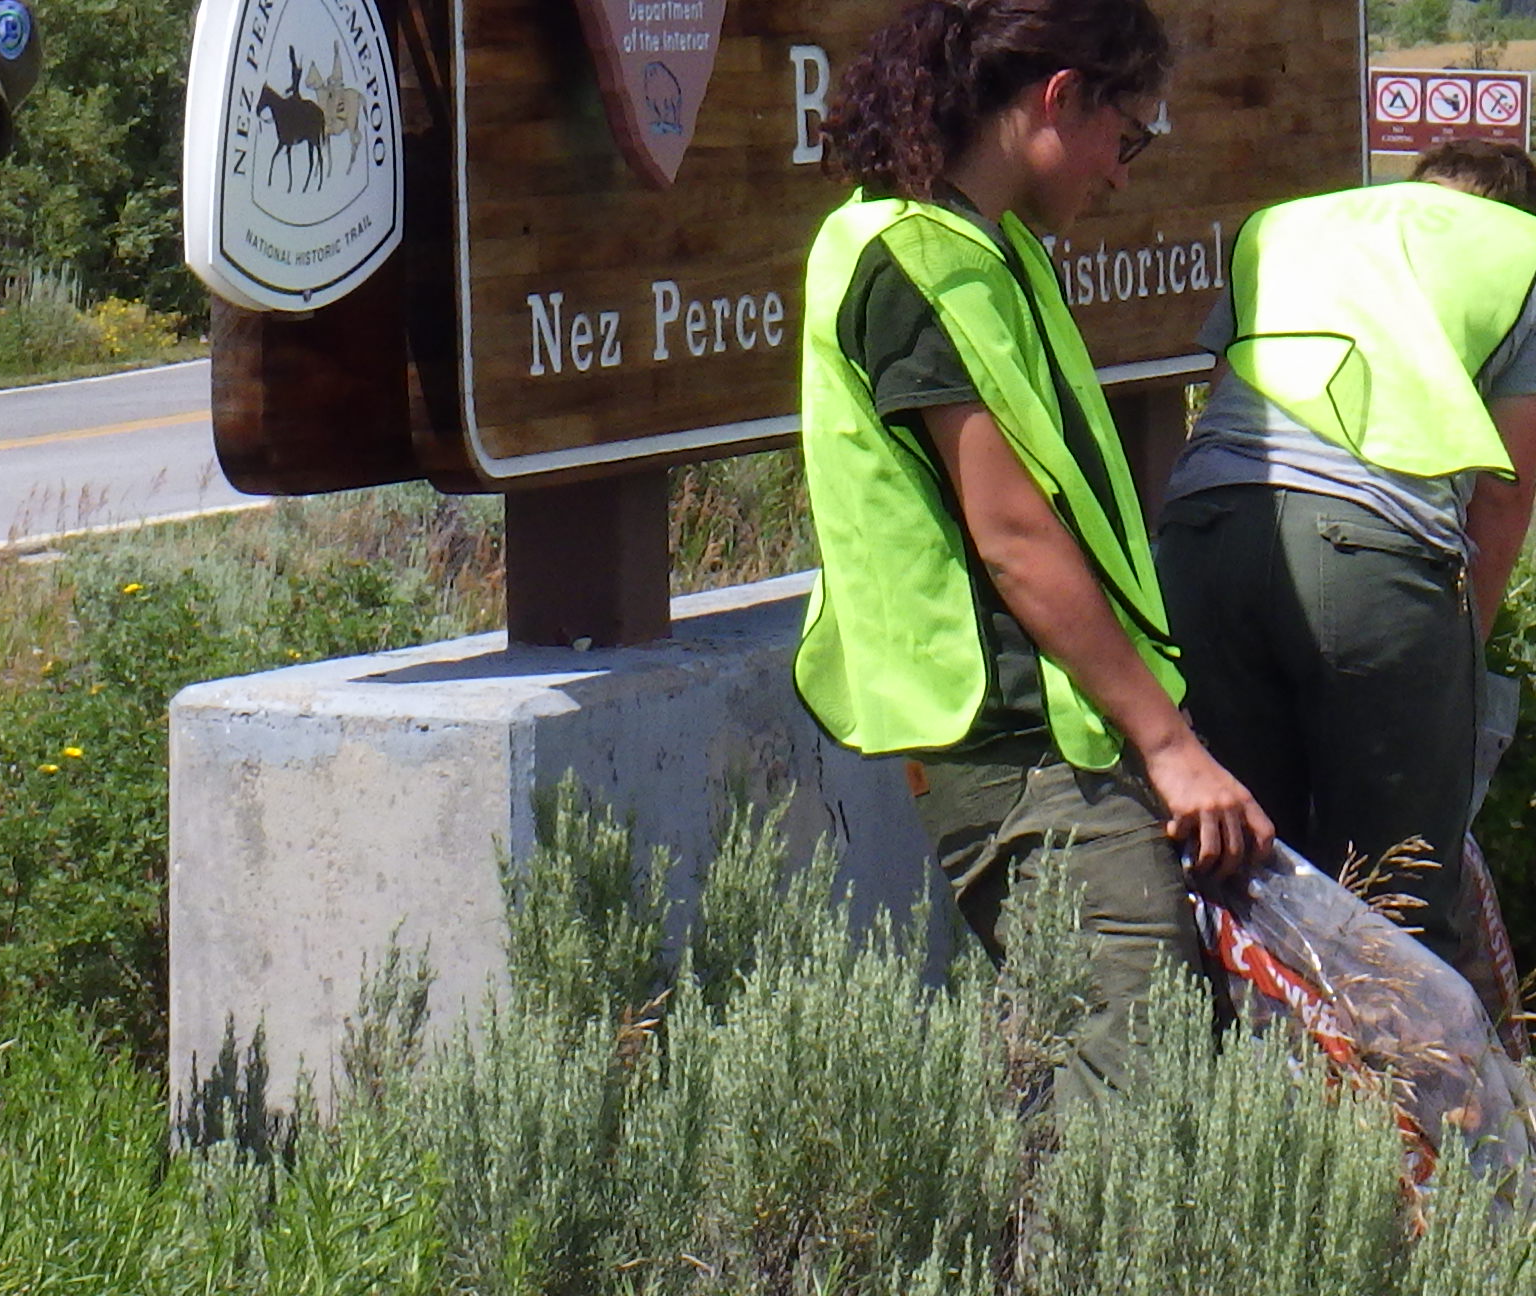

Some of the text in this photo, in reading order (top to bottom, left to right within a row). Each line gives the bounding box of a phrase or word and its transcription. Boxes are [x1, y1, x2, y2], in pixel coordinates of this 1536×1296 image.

[623, 26, 711, 53] of the Interior
[233, 85, 255, 176] NEZ
[245, 214, 373, 266] NATIONAL HISTORIC TRAIL
[527, 220, 1225, 376] Nez Perce istorical
